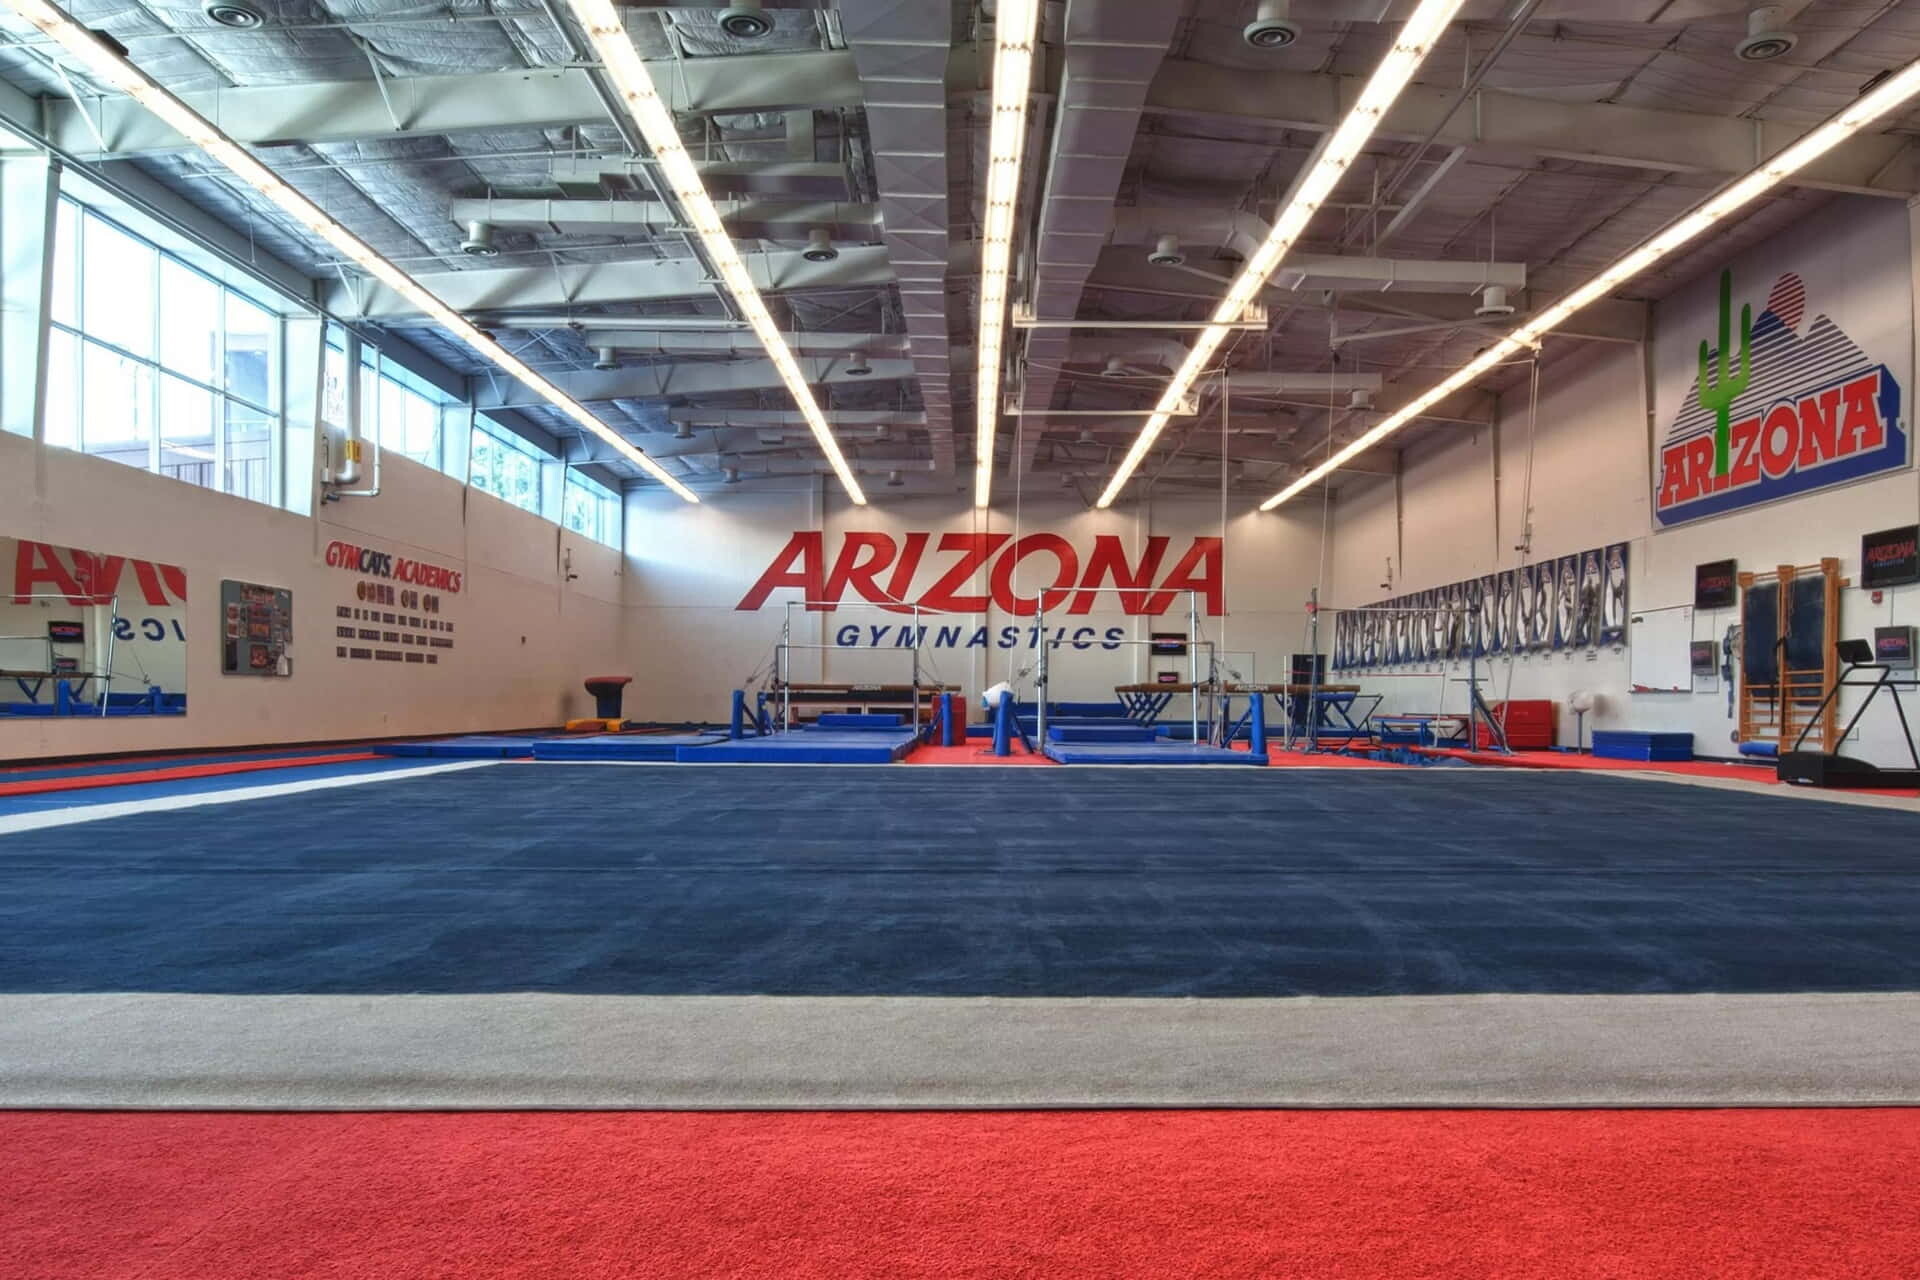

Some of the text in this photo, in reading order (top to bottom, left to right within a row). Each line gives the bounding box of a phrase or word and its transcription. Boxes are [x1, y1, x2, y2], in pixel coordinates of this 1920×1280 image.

[1658, 374, 1884, 508] ARIZONA
[325, 540, 462, 593] GYMCATS ACADEMICS
[735, 530, 1227, 617] ARIZONA
[836, 624, 1126, 650] GYMNASTICS
